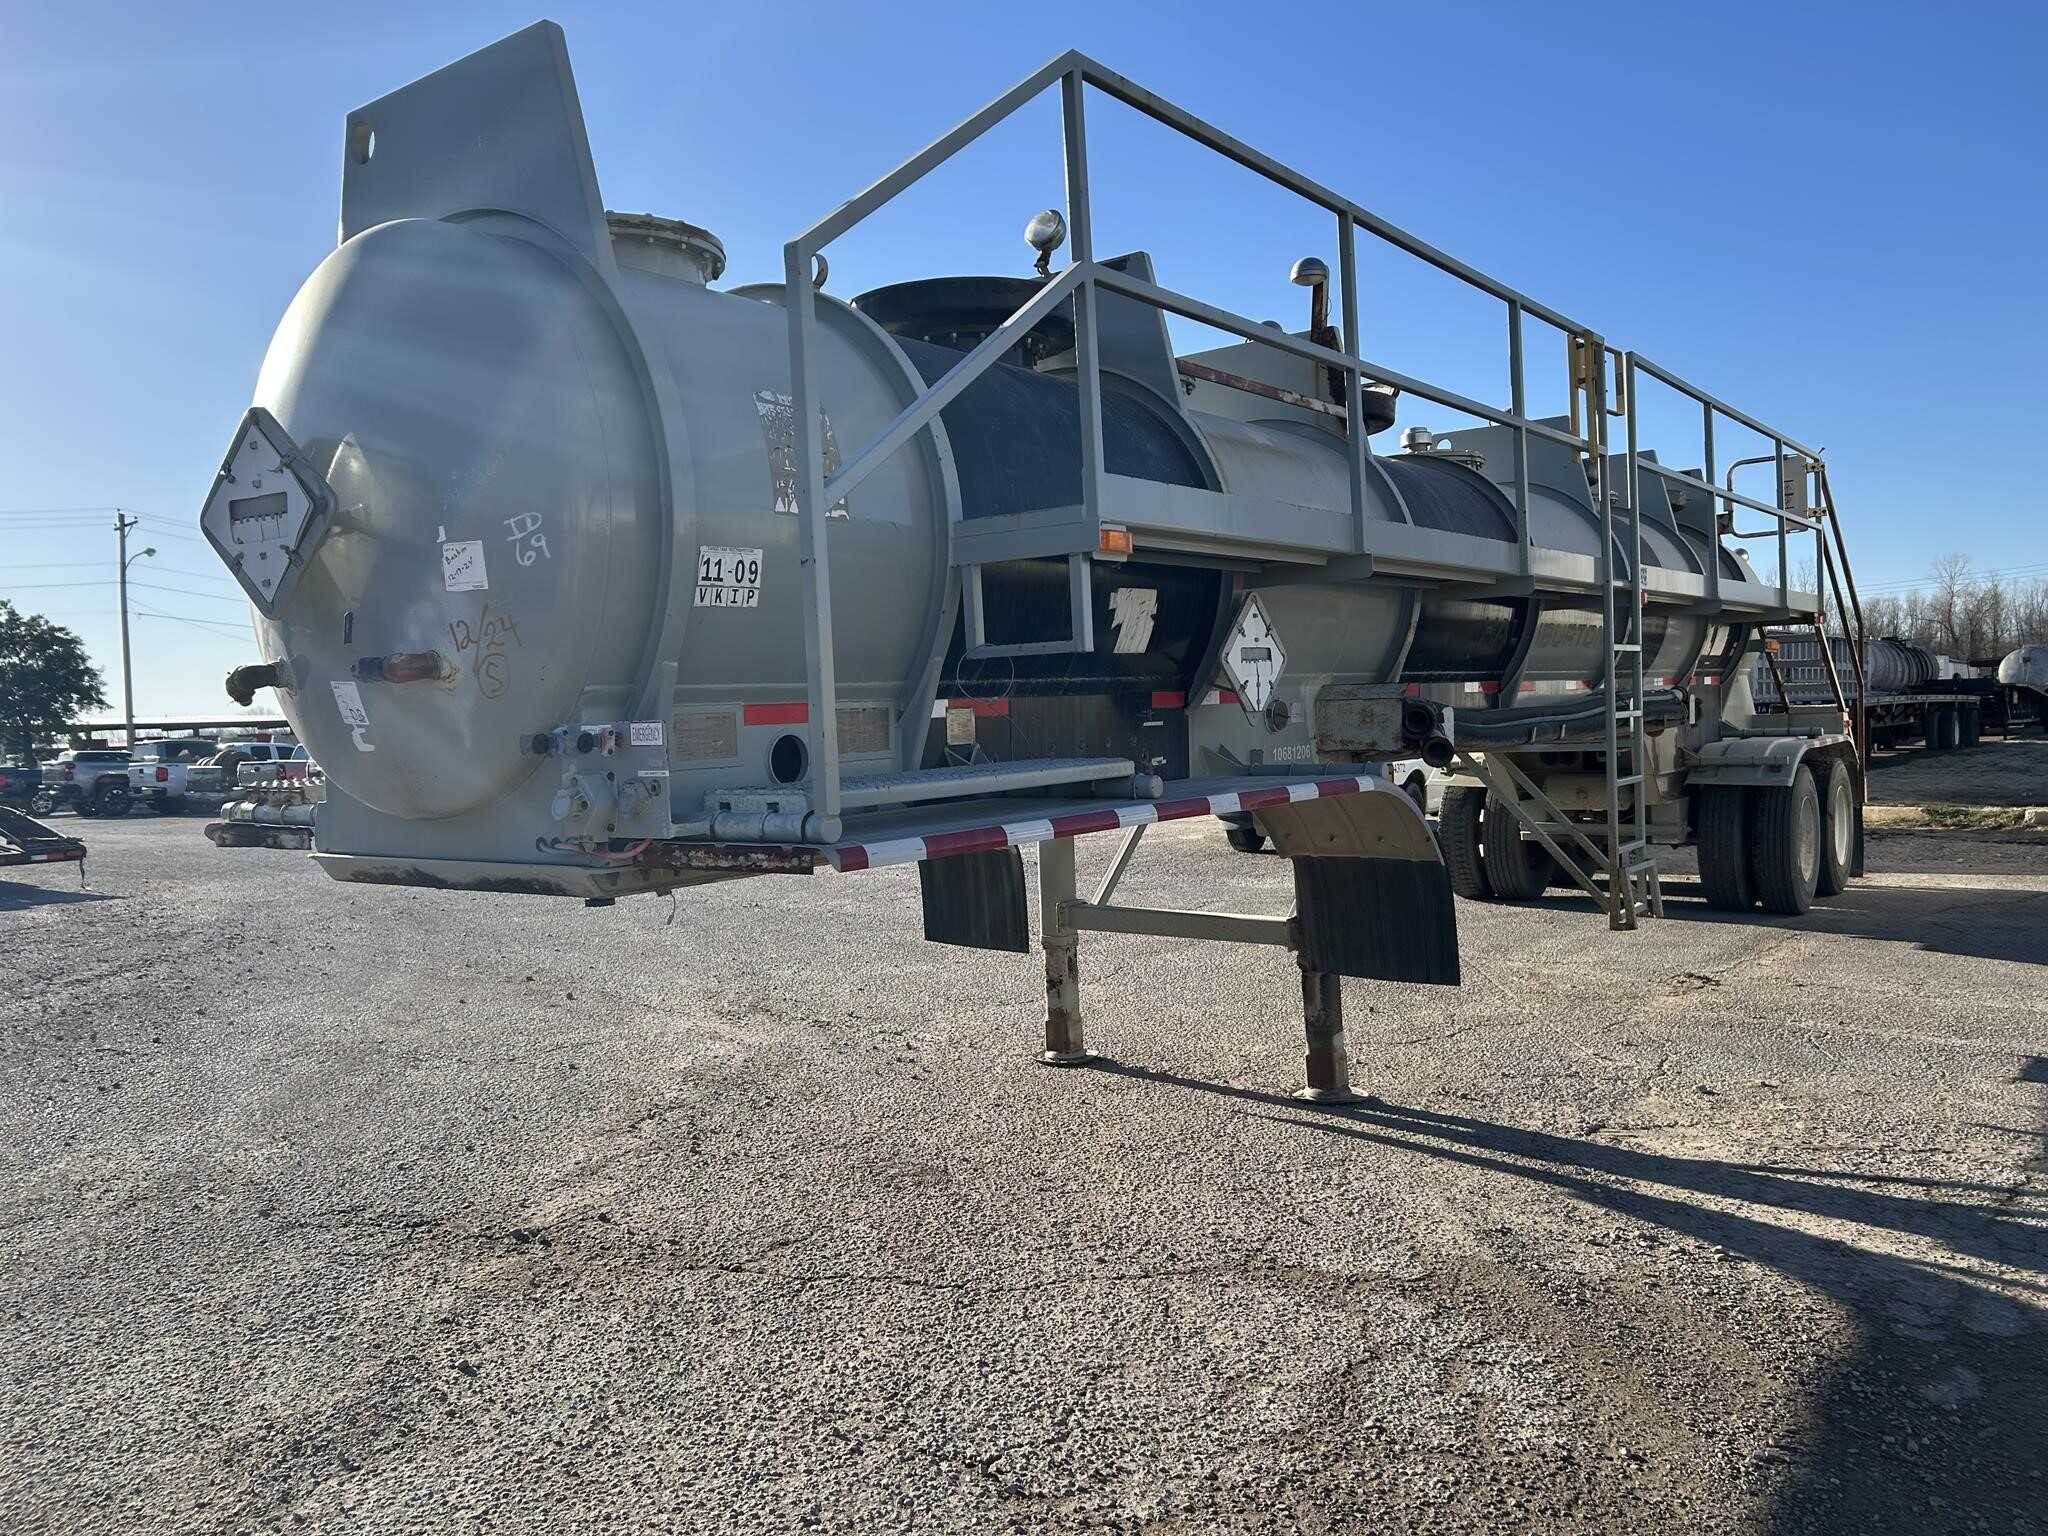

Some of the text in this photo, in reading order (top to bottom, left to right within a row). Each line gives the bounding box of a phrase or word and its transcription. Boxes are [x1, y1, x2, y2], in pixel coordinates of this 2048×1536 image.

[504, 512, 542, 541] ID
[515, 533, 551, 566] 69
[701, 557, 759, 584] 11-09
[449, 603, 523, 655] 12/24
[1273, 745, 1311, 761] 10681206
